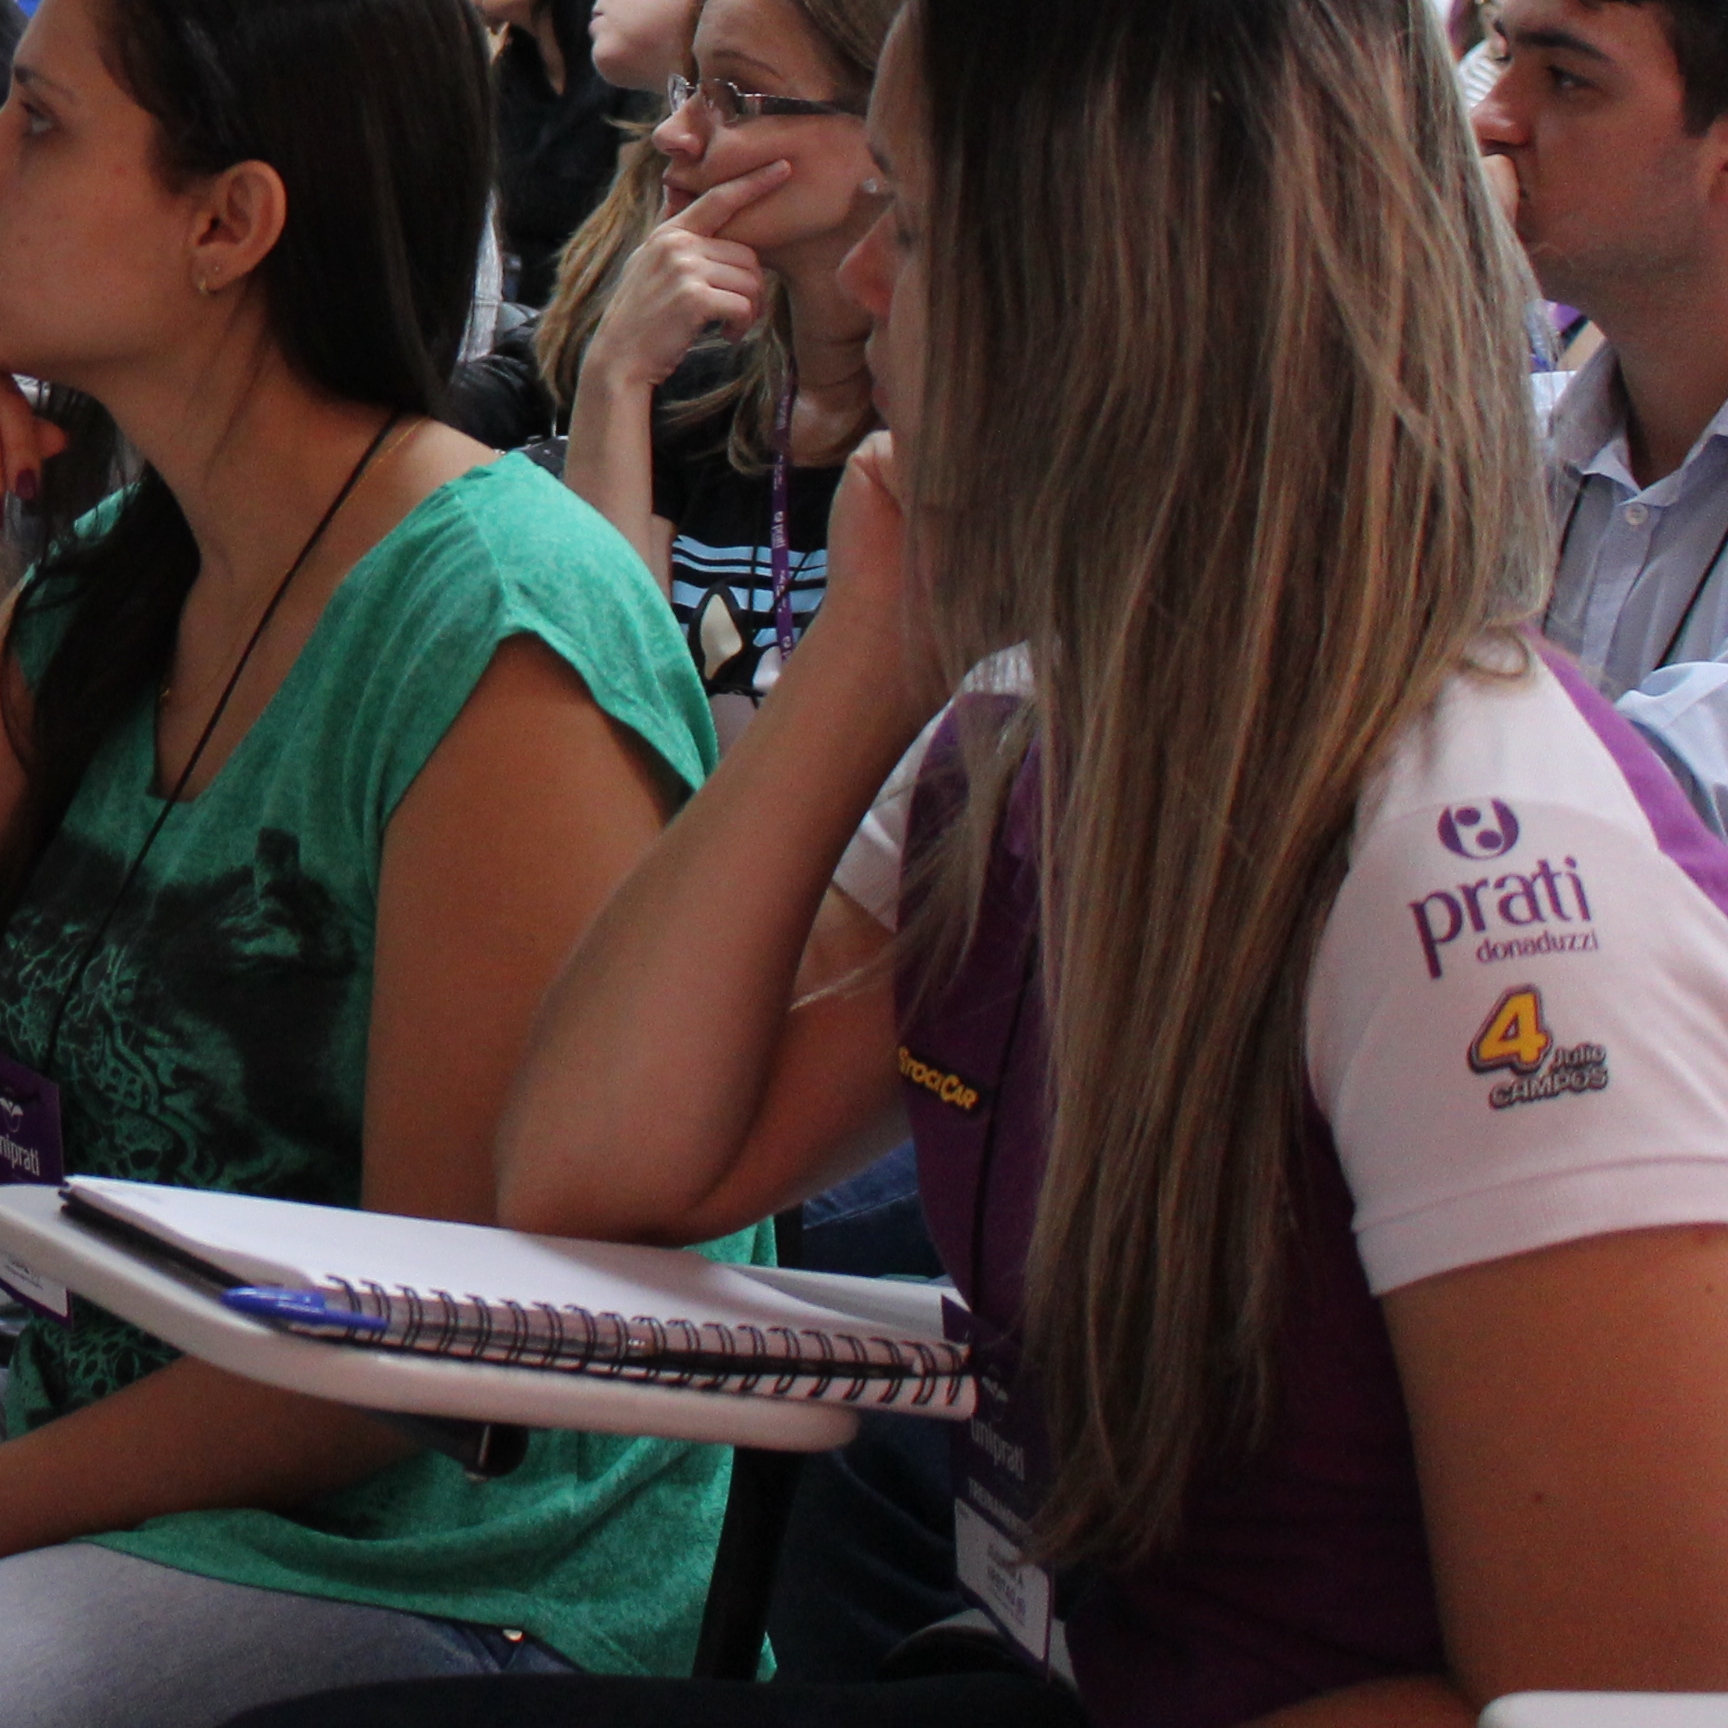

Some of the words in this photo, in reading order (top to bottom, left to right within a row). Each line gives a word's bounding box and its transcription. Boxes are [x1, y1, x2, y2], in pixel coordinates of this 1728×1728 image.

[1407, 856, 1592, 980] prati
[1475, 928, 1599, 964] donaduzzi
[1468, 983, 1552, 1074] 4
